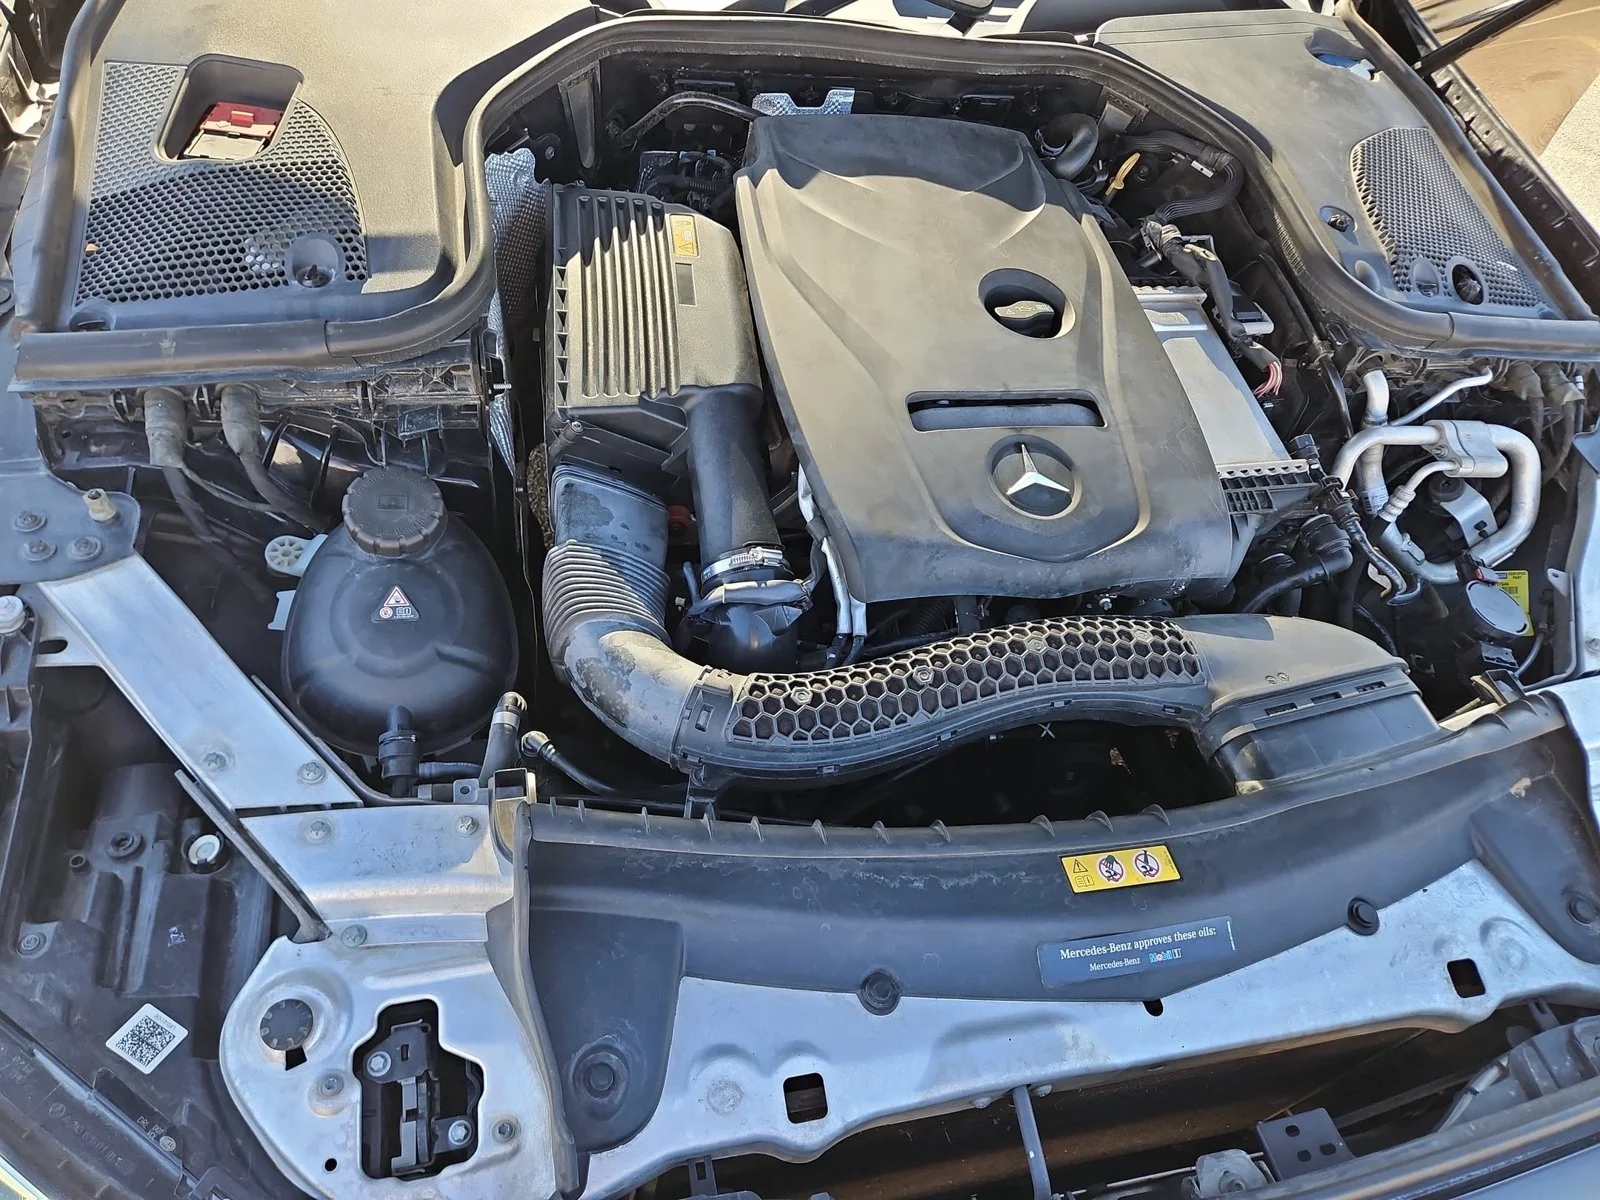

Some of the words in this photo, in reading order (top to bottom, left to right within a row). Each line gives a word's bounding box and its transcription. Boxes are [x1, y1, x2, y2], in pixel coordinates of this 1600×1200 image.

[1060, 942, 1132, 960] Mercedes-Benz
[1134, 934, 1173, 949] approves
[1174, 930, 1197, 942] these
[1198, 926, 1217, 938] oils:
[1089, 957, 1141, 971] Mercedes-Benz
